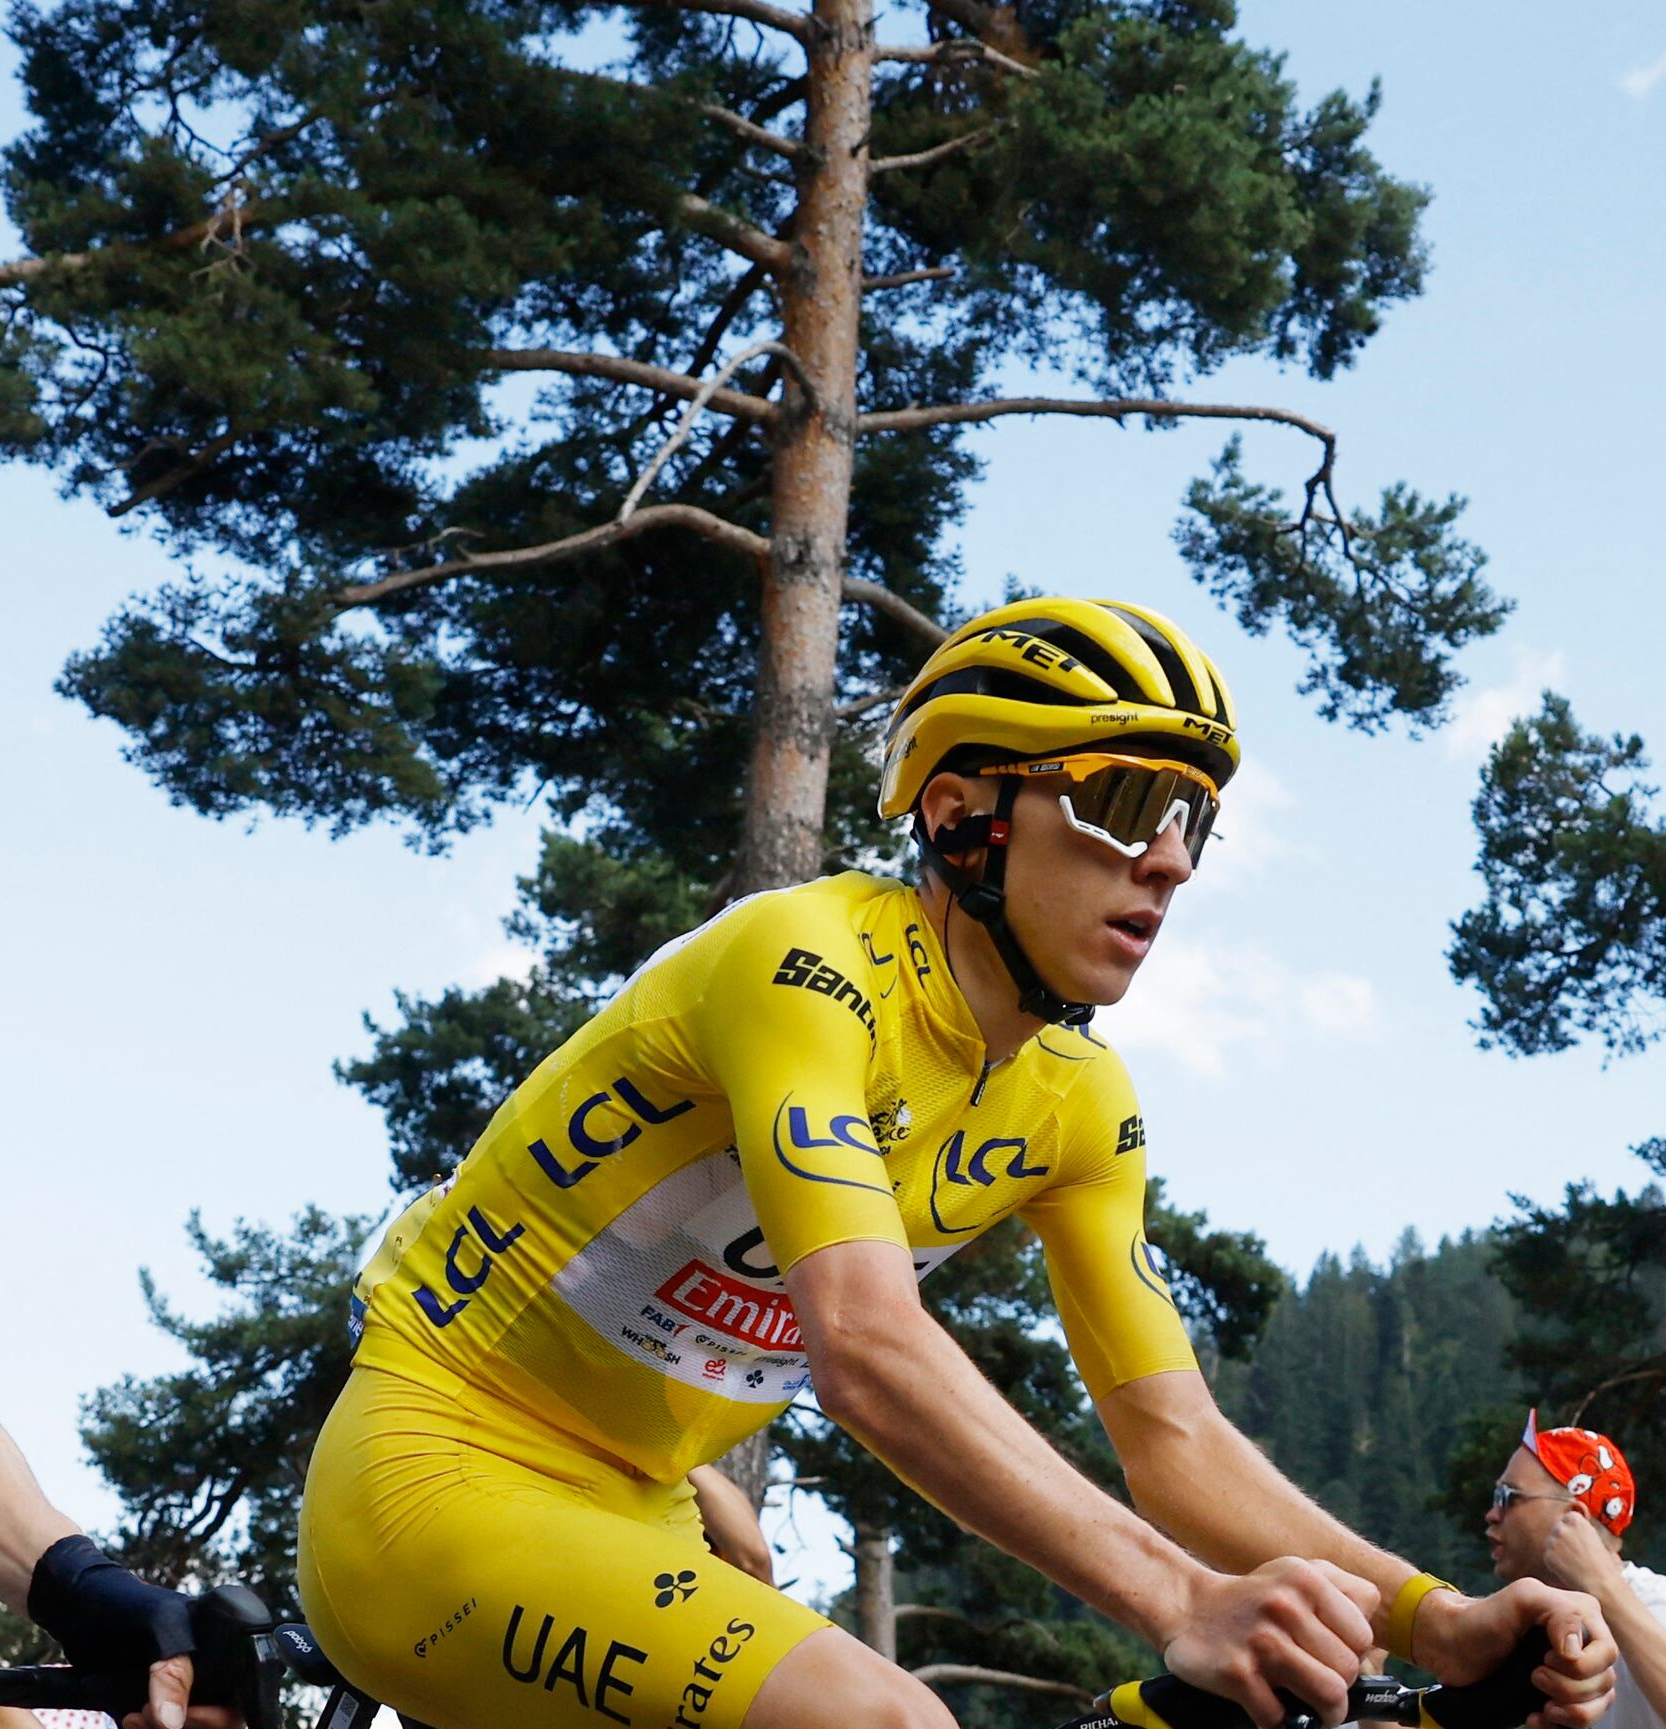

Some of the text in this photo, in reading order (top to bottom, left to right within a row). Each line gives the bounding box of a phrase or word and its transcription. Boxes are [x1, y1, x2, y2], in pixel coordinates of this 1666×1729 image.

[981, 627, 1091, 674] MET
[1091, 711, 1140, 726] presight
[1183, 716, 1235, 746] MET
[527, 1075, 696, 1190] LCL
[946, 1130, 1050, 1187] LCL
[411, 1204, 526, 1329] LCL
[431, 1597, 477, 1647] PISSEI
[501, 1603, 648, 1727] UAE
